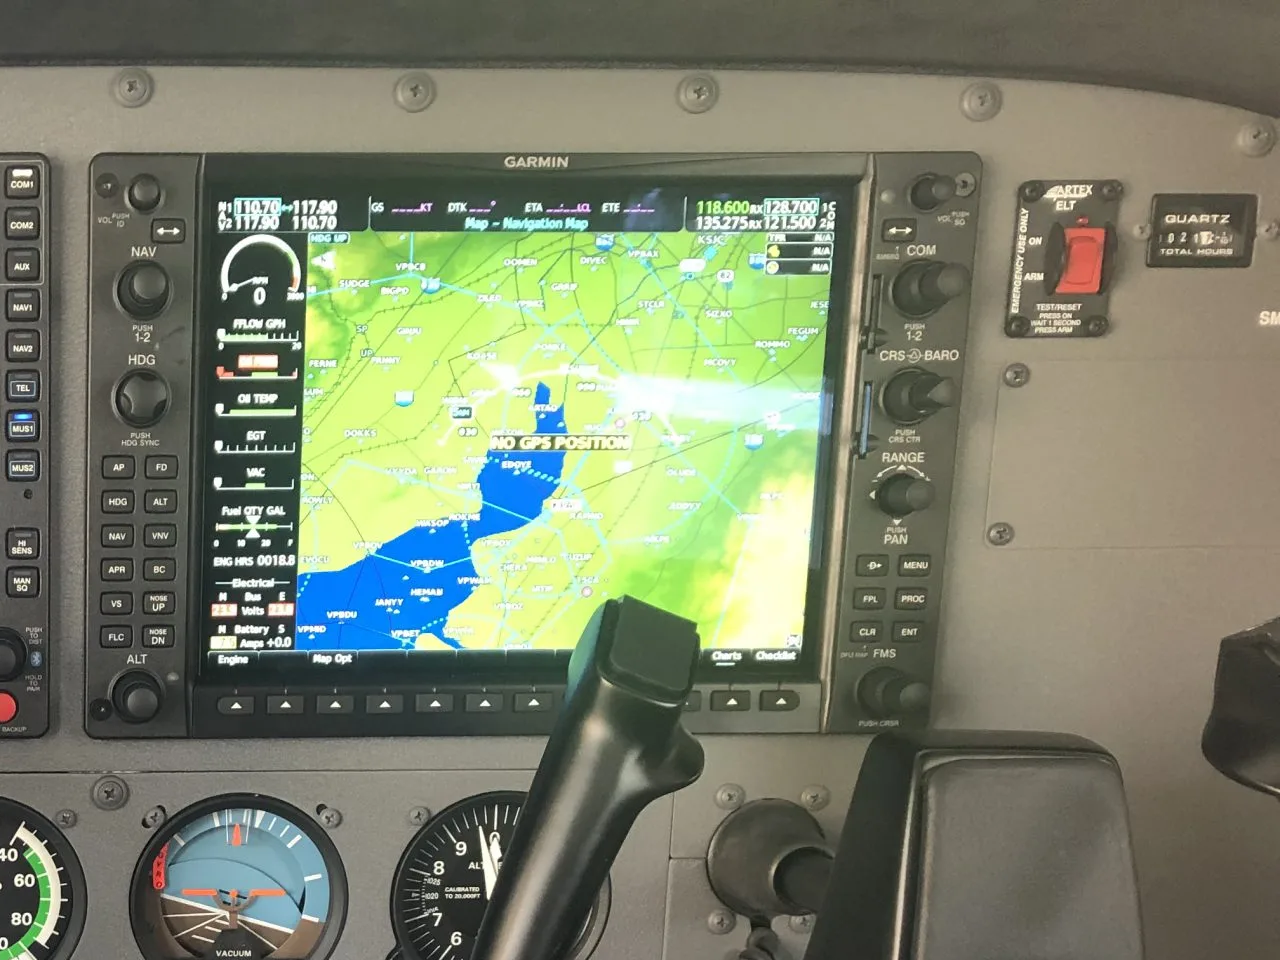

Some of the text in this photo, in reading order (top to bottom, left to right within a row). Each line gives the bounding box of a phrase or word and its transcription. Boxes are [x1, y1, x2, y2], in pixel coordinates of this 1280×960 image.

[504, 156, 568, 168] GARMIN
[236, 200, 337, 215] 110.70 117.90
[1056, 200, 1076, 211] ELT
[236, 215, 337, 230] 117.90 110.70
[1165, 214, 1230, 224] QUARTZ
[131, 247, 156, 257] NAV
[129, 355, 155, 365] HDG
[492, 435, 629, 450] NO GPS POSITION
[222, 506, 241, 516] Fuel
[266, 506, 285, 515] GAL
[214, 555, 295, 566] ENG HRS 0018.8
[218, 655, 248, 666] Engine
[313, 654, 352, 664] Map Opt
[14, 874, 35, 887] 60
[11, 913, 32, 925] 80
